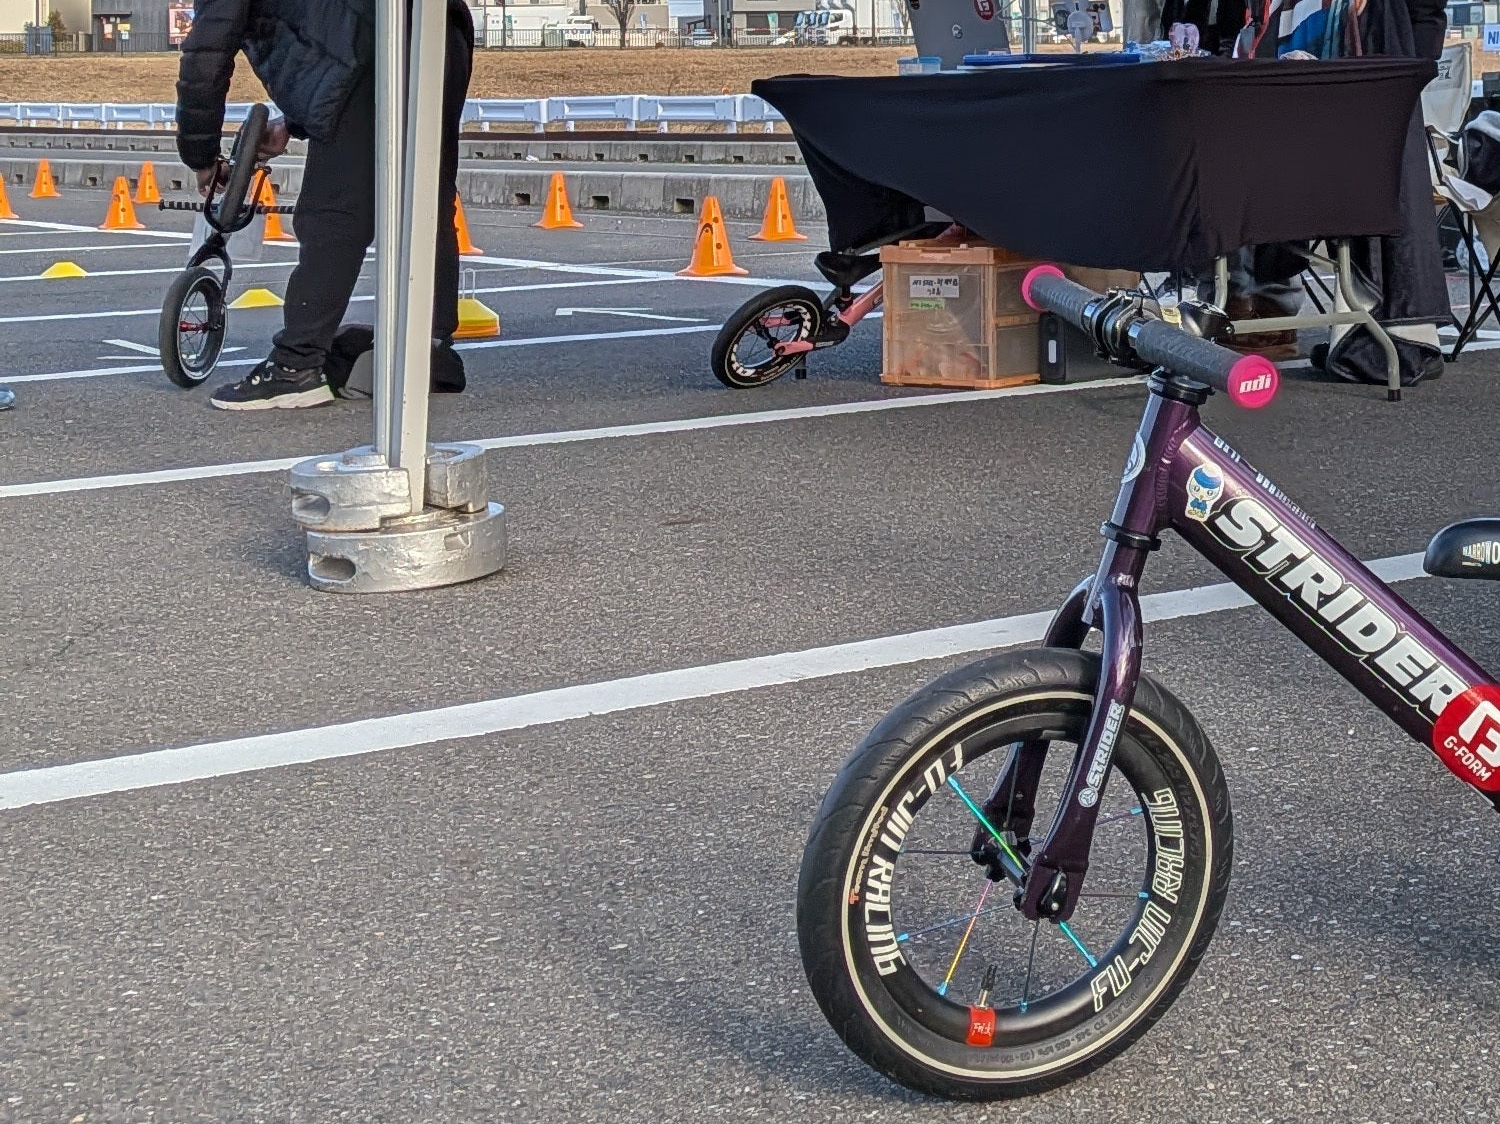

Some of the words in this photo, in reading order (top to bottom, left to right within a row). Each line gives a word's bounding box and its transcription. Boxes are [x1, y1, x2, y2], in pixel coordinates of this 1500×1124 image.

[1215, 496, 1472, 718] STRIDER
[1089, 699, 1126, 790] STRIDER
[1443, 735, 1493, 782] G-FORM
